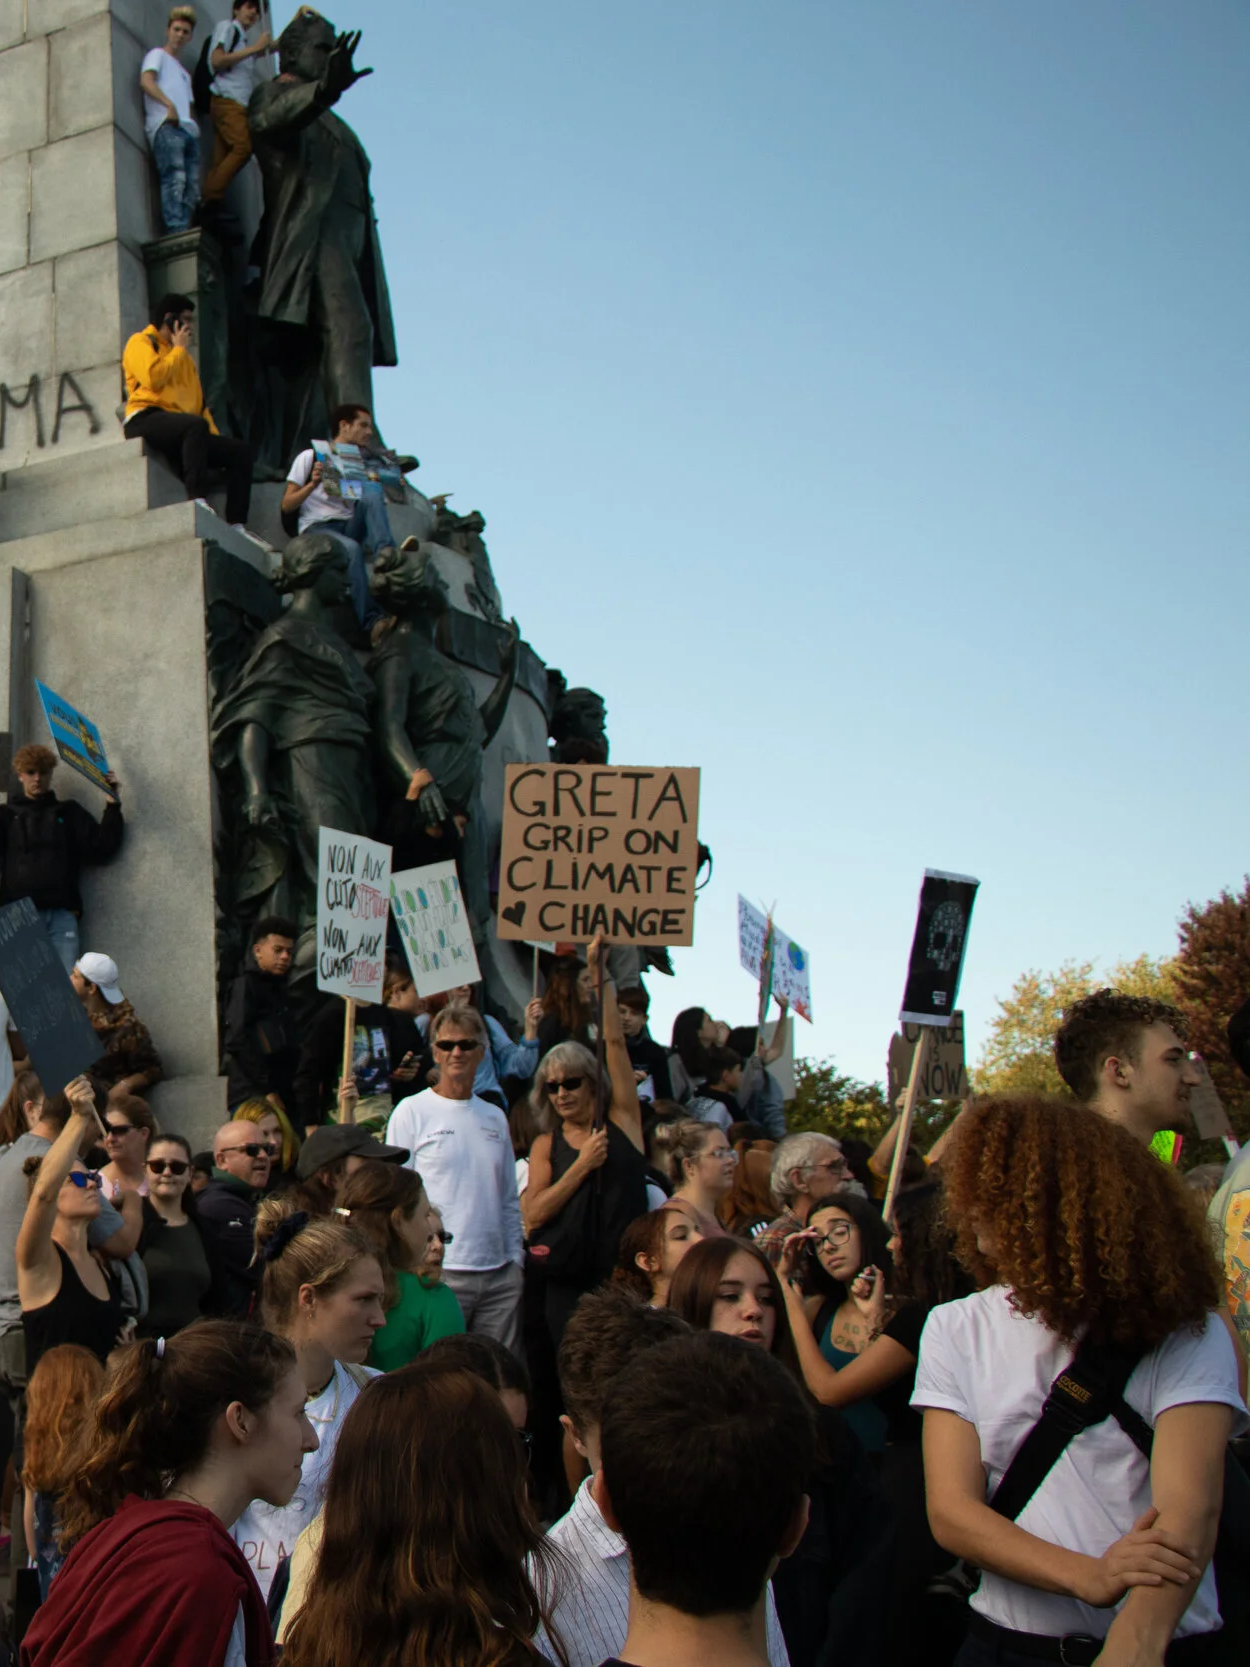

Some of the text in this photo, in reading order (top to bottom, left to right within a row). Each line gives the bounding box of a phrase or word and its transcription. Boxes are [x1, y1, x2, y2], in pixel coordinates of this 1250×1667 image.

[509, 768, 688, 824] GRETA
[623, 828, 680, 856] ON
[327, 844, 386, 882] NON AUX
[323, 918, 383, 957] NON AUX
[538, 900, 687, 939] CHANGE
[918, 1061, 963, 1097] NOW
